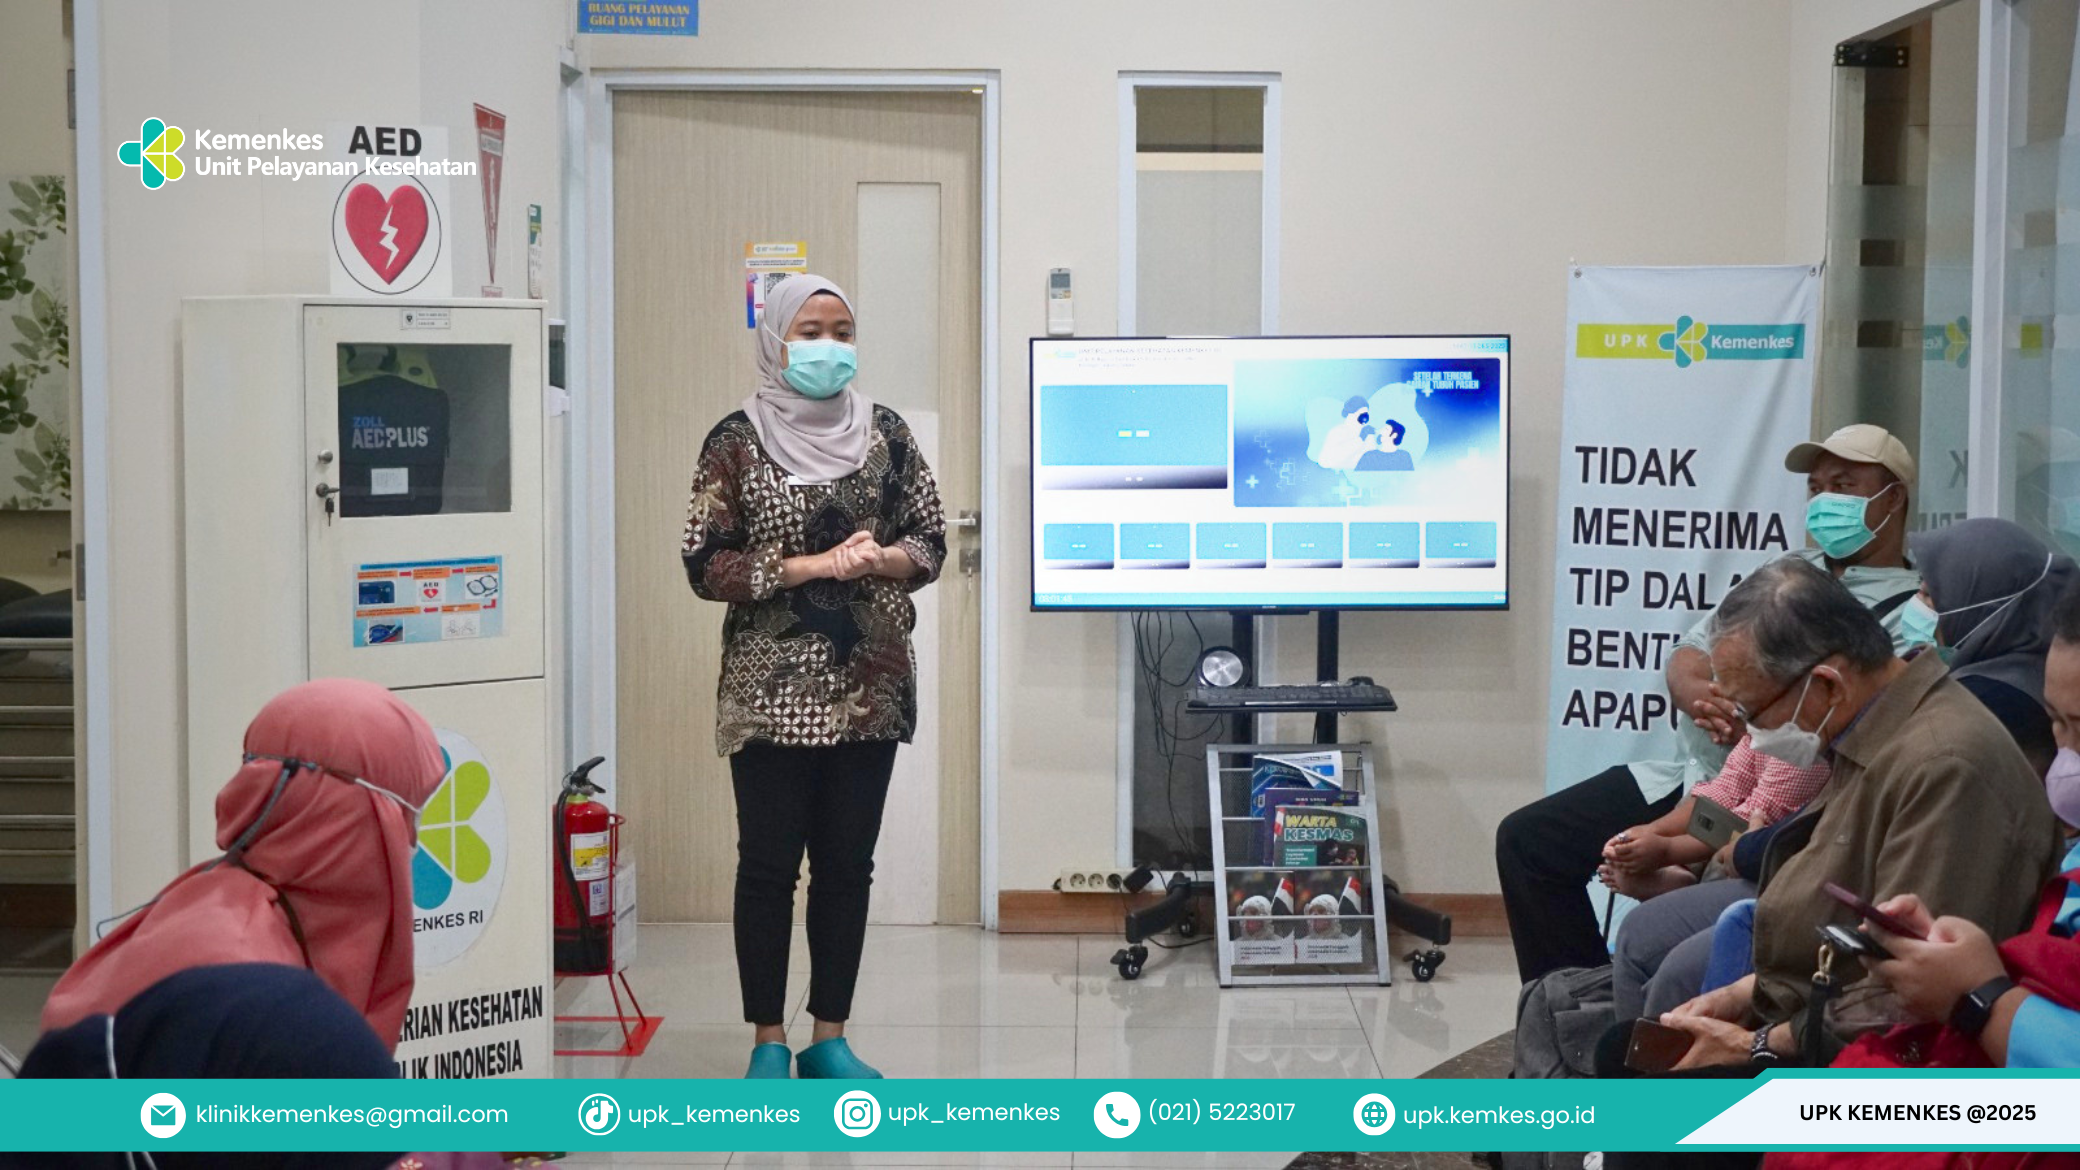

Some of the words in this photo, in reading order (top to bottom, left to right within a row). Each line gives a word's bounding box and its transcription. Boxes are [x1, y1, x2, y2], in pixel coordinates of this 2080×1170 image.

[590, 15, 615, 26] GIGI
[618, 16, 643, 26] DAN
[647, 17, 686, 27] MULUT
[629, 4, 689, 14] PELAYANAN
[348, 125, 422, 157] AED
[1711, 334, 1795, 349] Kemenkes
[353, 416, 385, 427] ZOLL
[1575, 445, 1698, 487] TIDAK
[1572, 506, 1789, 552] MENERIMA
[1570, 567, 1630, 607] TIP
[1567, 628, 1681, 671] BENT
[1284, 828, 1354, 842] KESMAS
[1285, 815, 1337, 828] WARTA
[413, 912, 465, 933] ENKES
[469, 909, 484, 925] RI
[398, 1003, 443, 1043] RIAN
[448, 985, 543, 1034] KESEHATAN
[435, 1039, 523, 1079] INDONESIA
